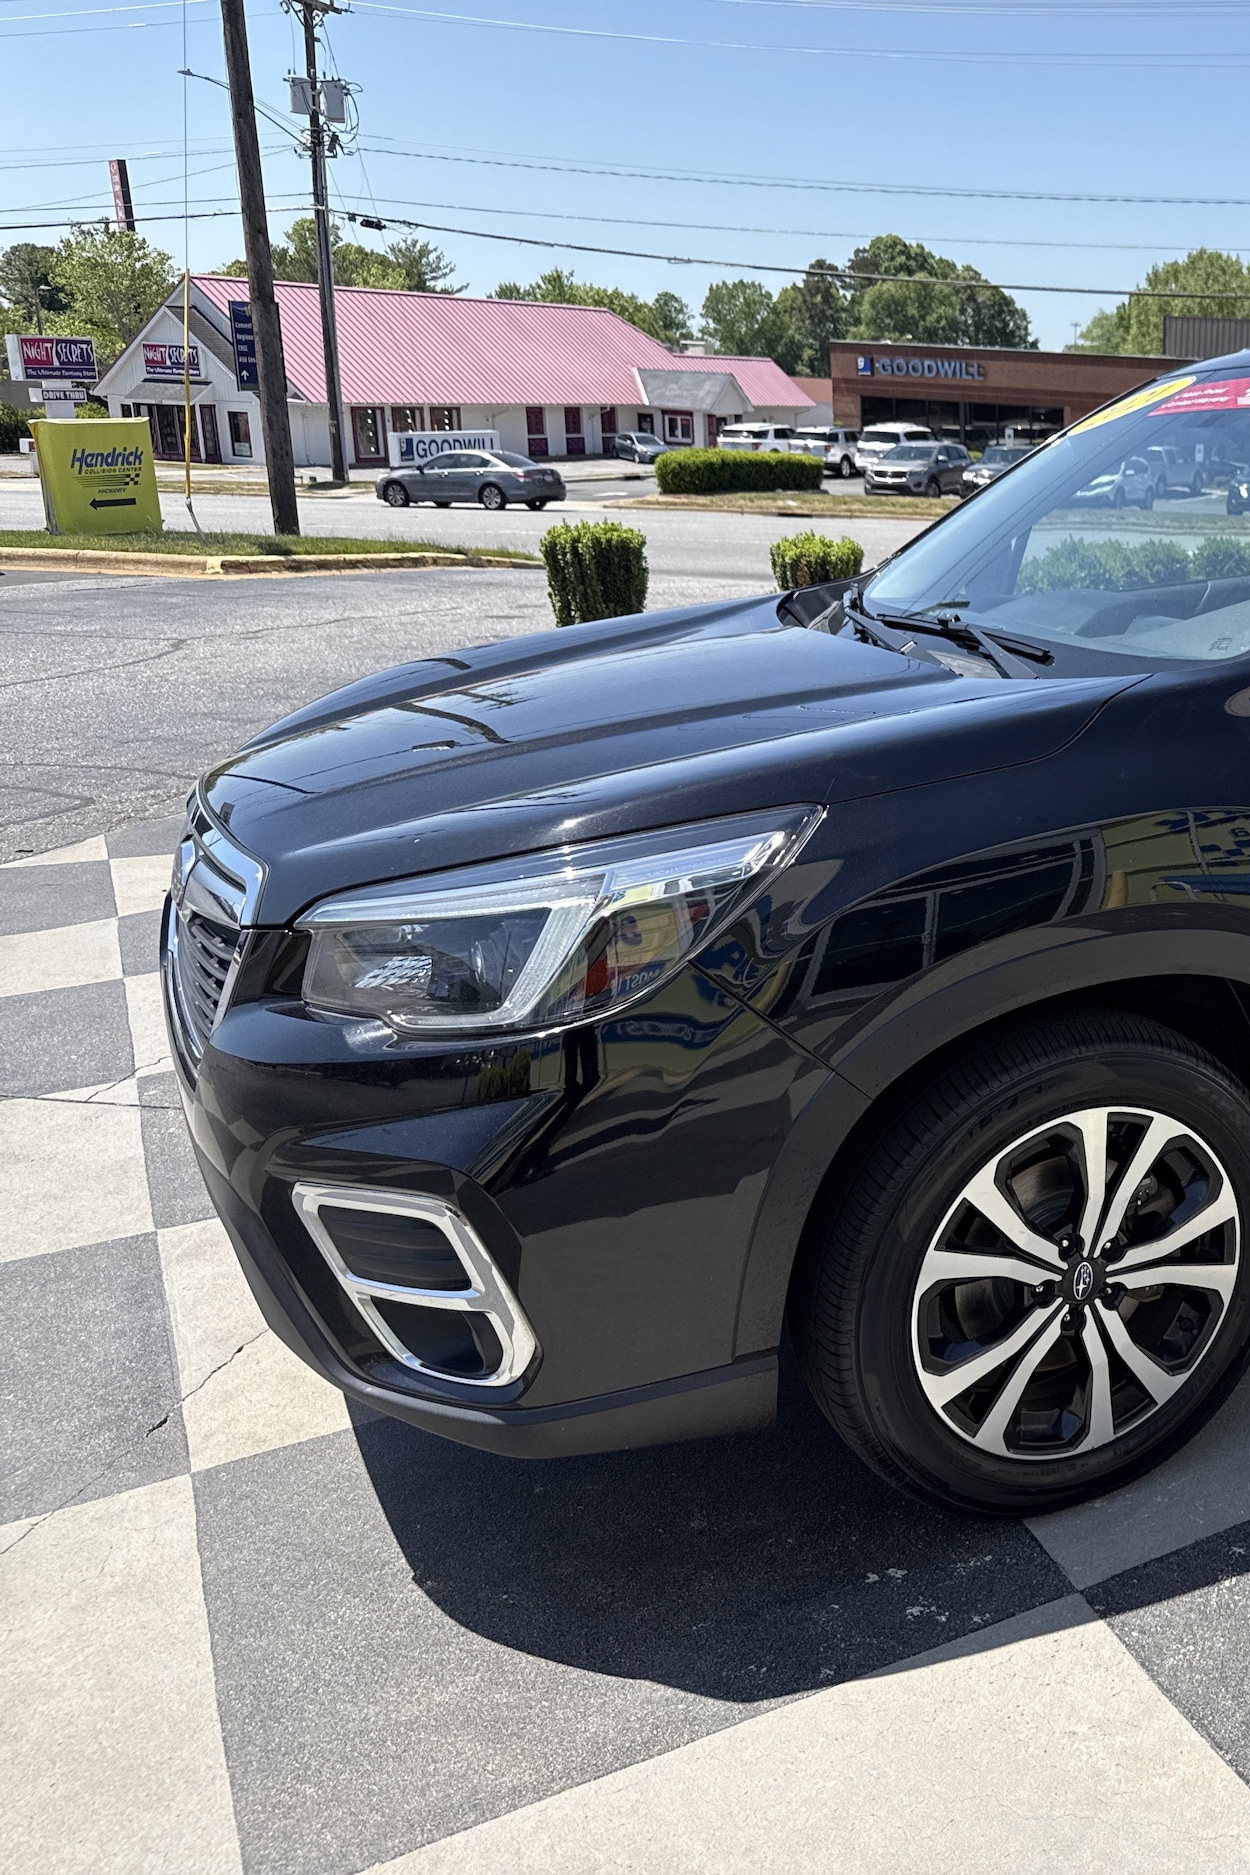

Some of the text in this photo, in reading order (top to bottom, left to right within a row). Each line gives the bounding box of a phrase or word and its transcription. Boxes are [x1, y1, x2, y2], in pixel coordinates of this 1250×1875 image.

[236, 333, 254, 341] Regiona
[57, 343, 94, 362] SECRETS
[170, 347, 198, 364] SECRTS
[878, 357, 985, 380] GOODWILL
[43, 391, 84, 399] DRIVE THRU
[416, 437, 494, 458] GOODWILL
[70, 446, 143, 475] Hendrick
[98, 487, 127, 495] HICKORY
